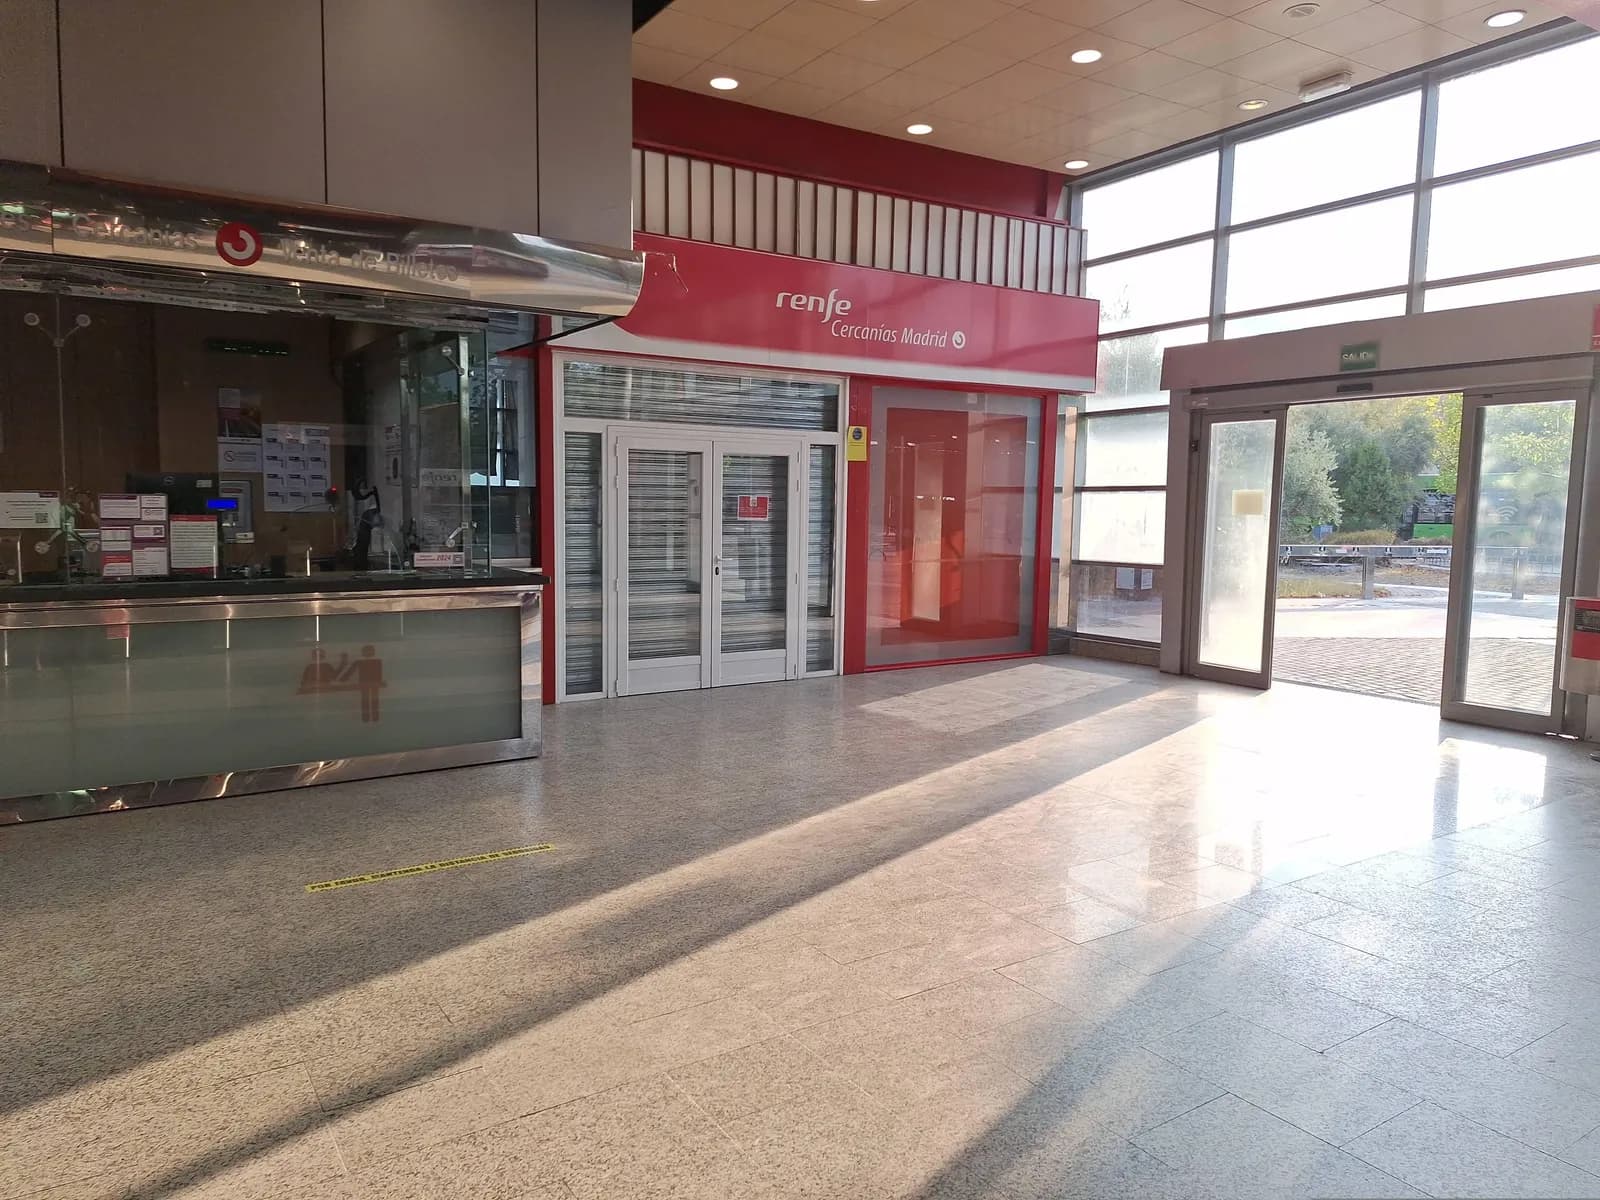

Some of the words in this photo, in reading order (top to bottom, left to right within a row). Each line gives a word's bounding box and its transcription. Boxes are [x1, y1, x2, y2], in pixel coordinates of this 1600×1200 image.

[776, 288, 852, 323] renfe
[832, 320, 897, 343] Cercanías
[901, 327, 948, 348] Madrid
